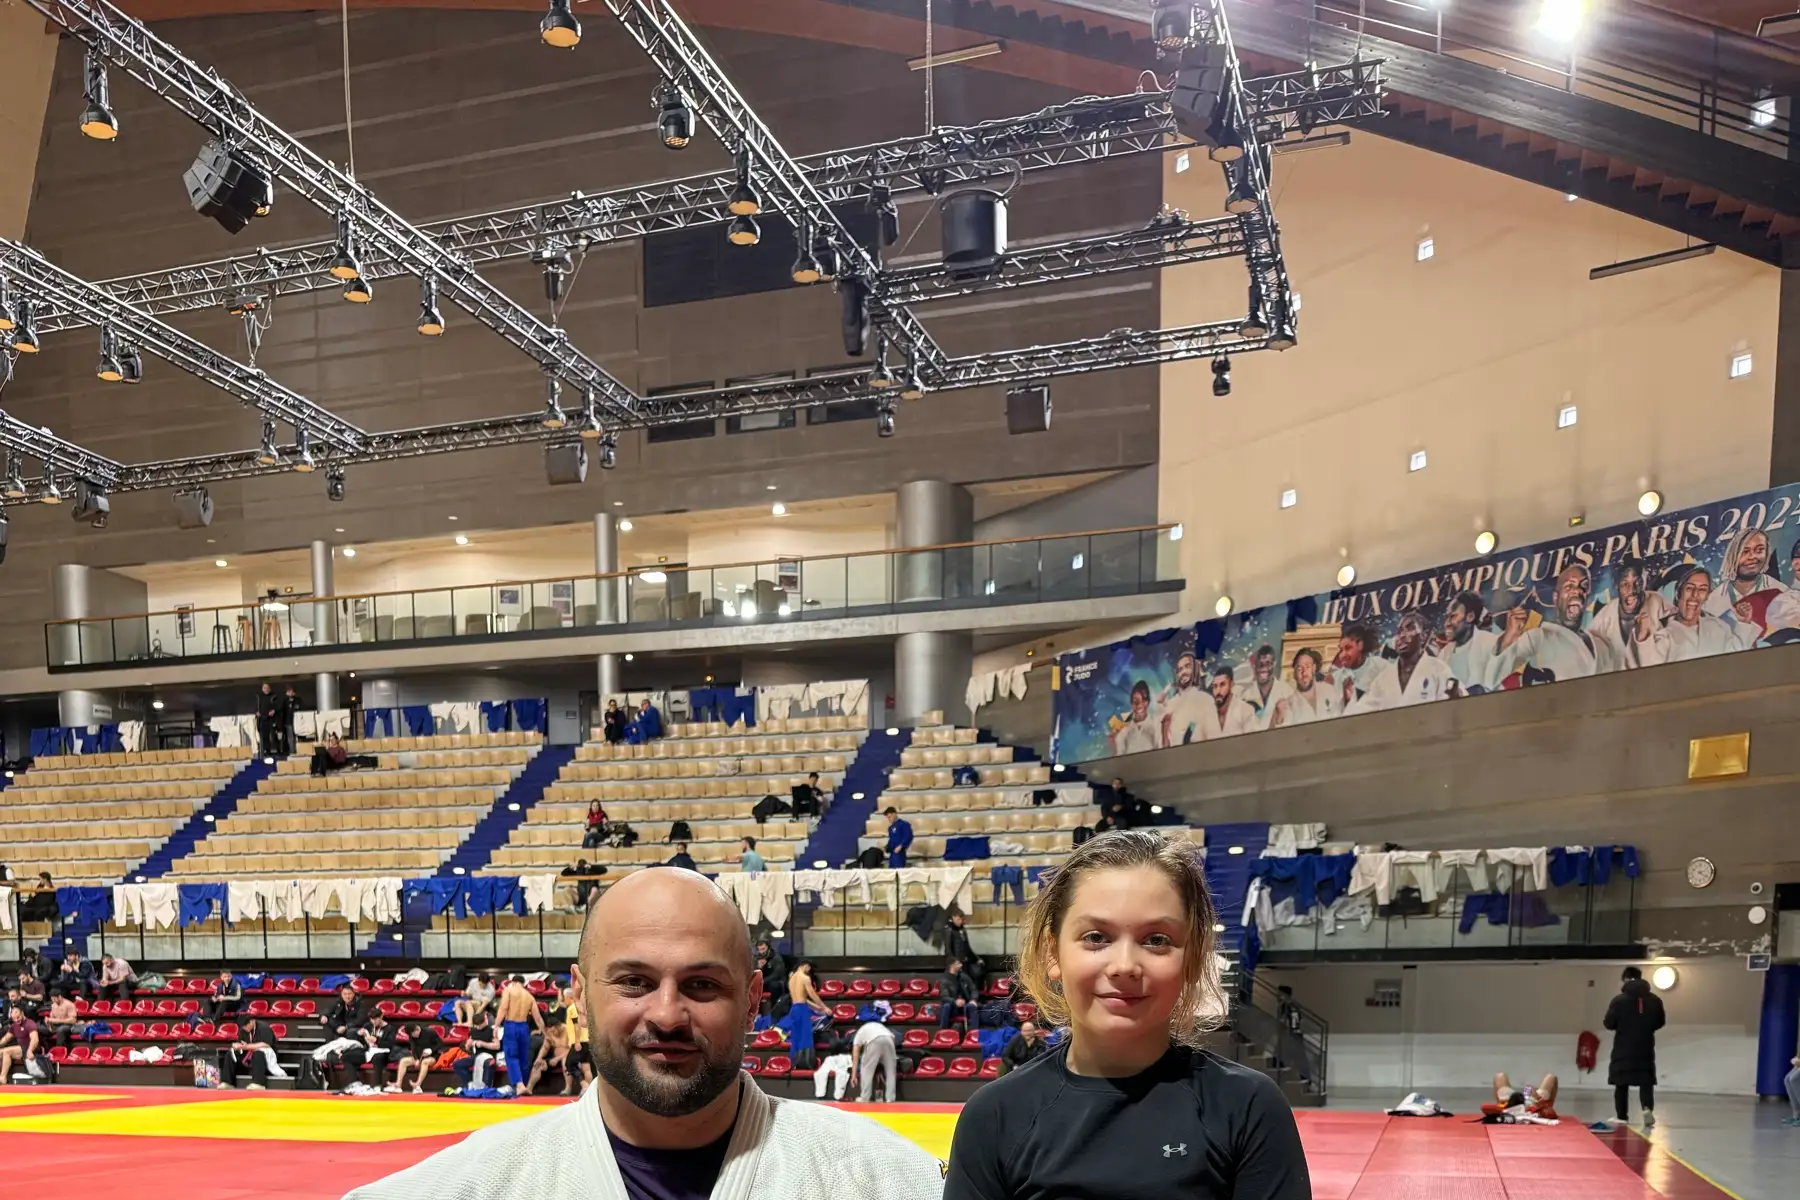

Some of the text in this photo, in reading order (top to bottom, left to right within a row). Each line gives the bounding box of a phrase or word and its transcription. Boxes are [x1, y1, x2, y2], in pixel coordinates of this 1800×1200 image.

[1317, 589, 1387, 624] JEUX
[1390, 541, 1596, 611] OLYMPIQUES
[1599, 515, 1710, 567] PARIS
[1074, 662, 1098, 673] FRANCE
[1073, 671, 1091, 681] JUDO
